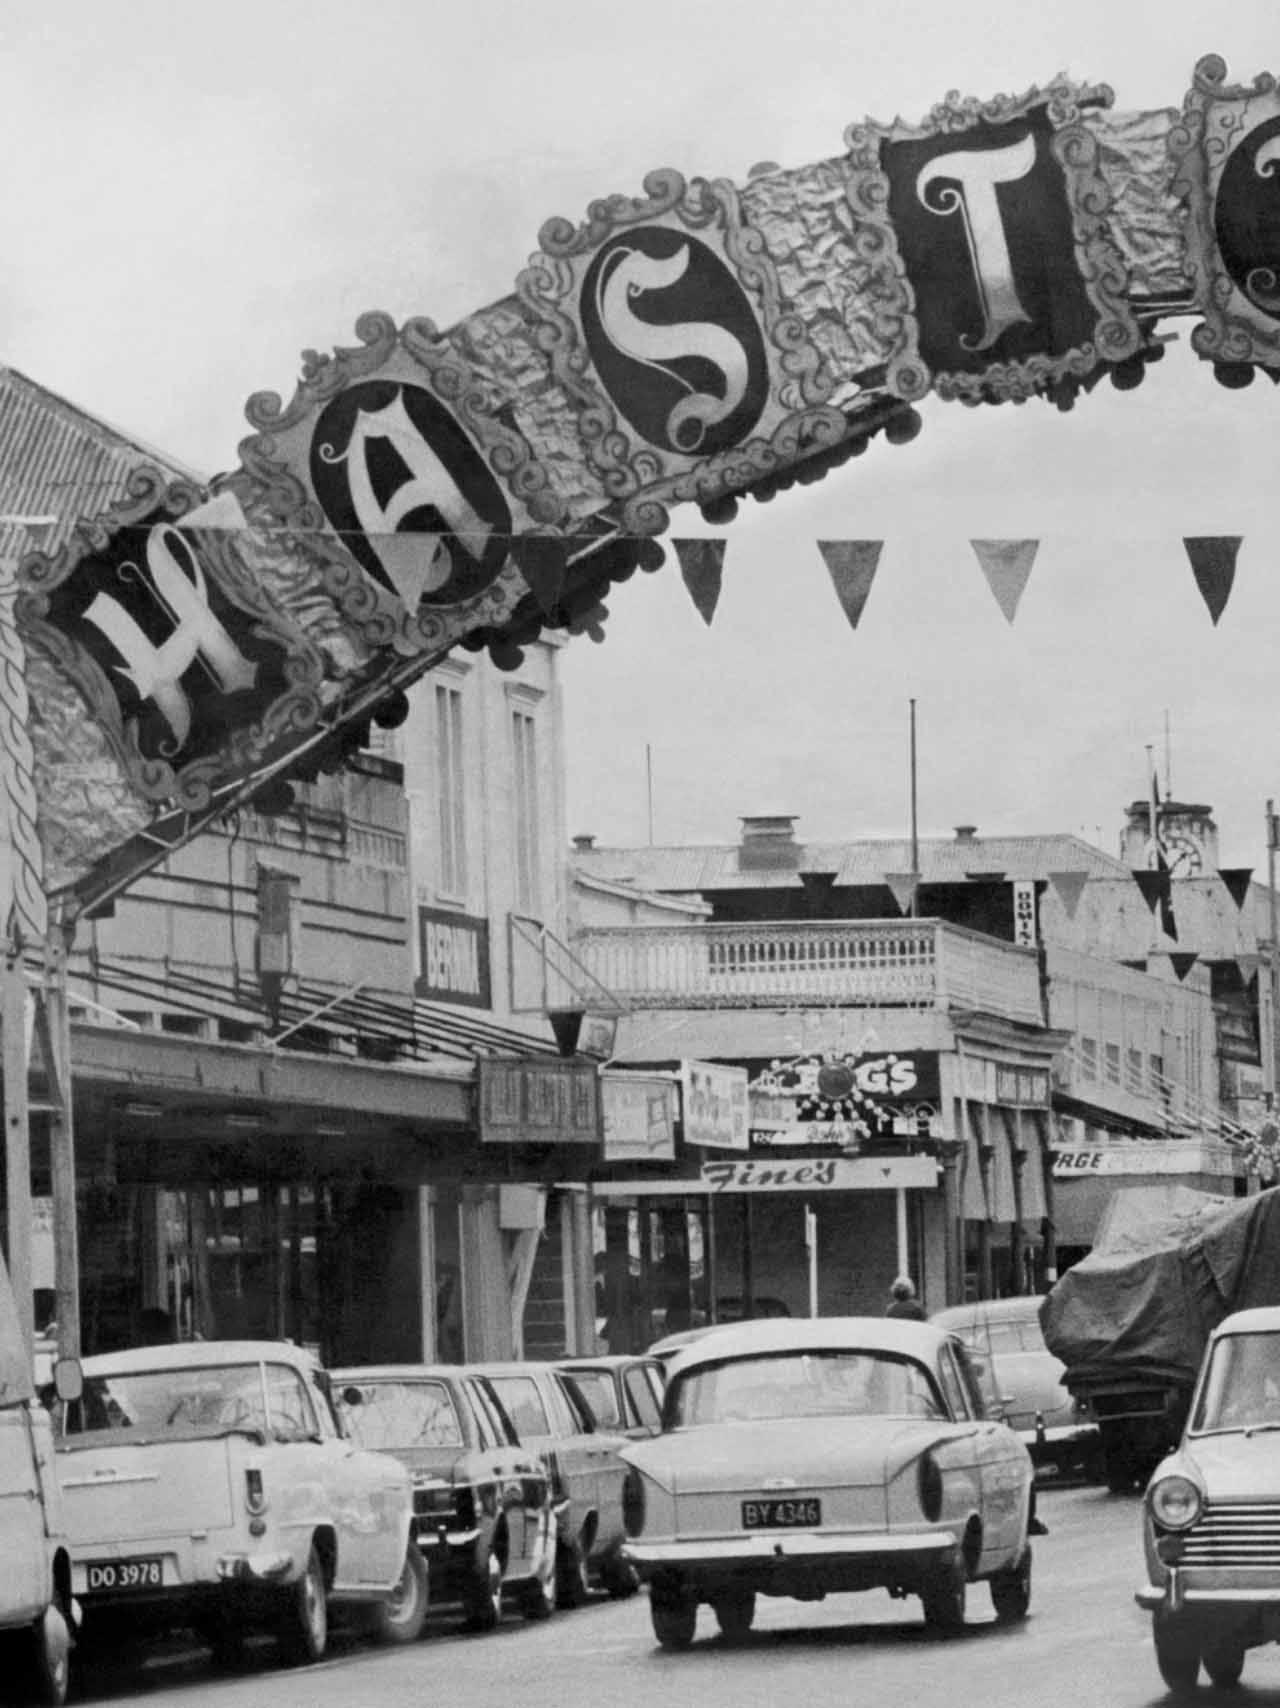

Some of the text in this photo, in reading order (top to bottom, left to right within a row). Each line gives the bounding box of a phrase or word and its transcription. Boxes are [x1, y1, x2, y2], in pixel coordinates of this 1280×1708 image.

[745, 1504, 770, 1524] BY
[90, 1563, 160, 1586] DO 3978
